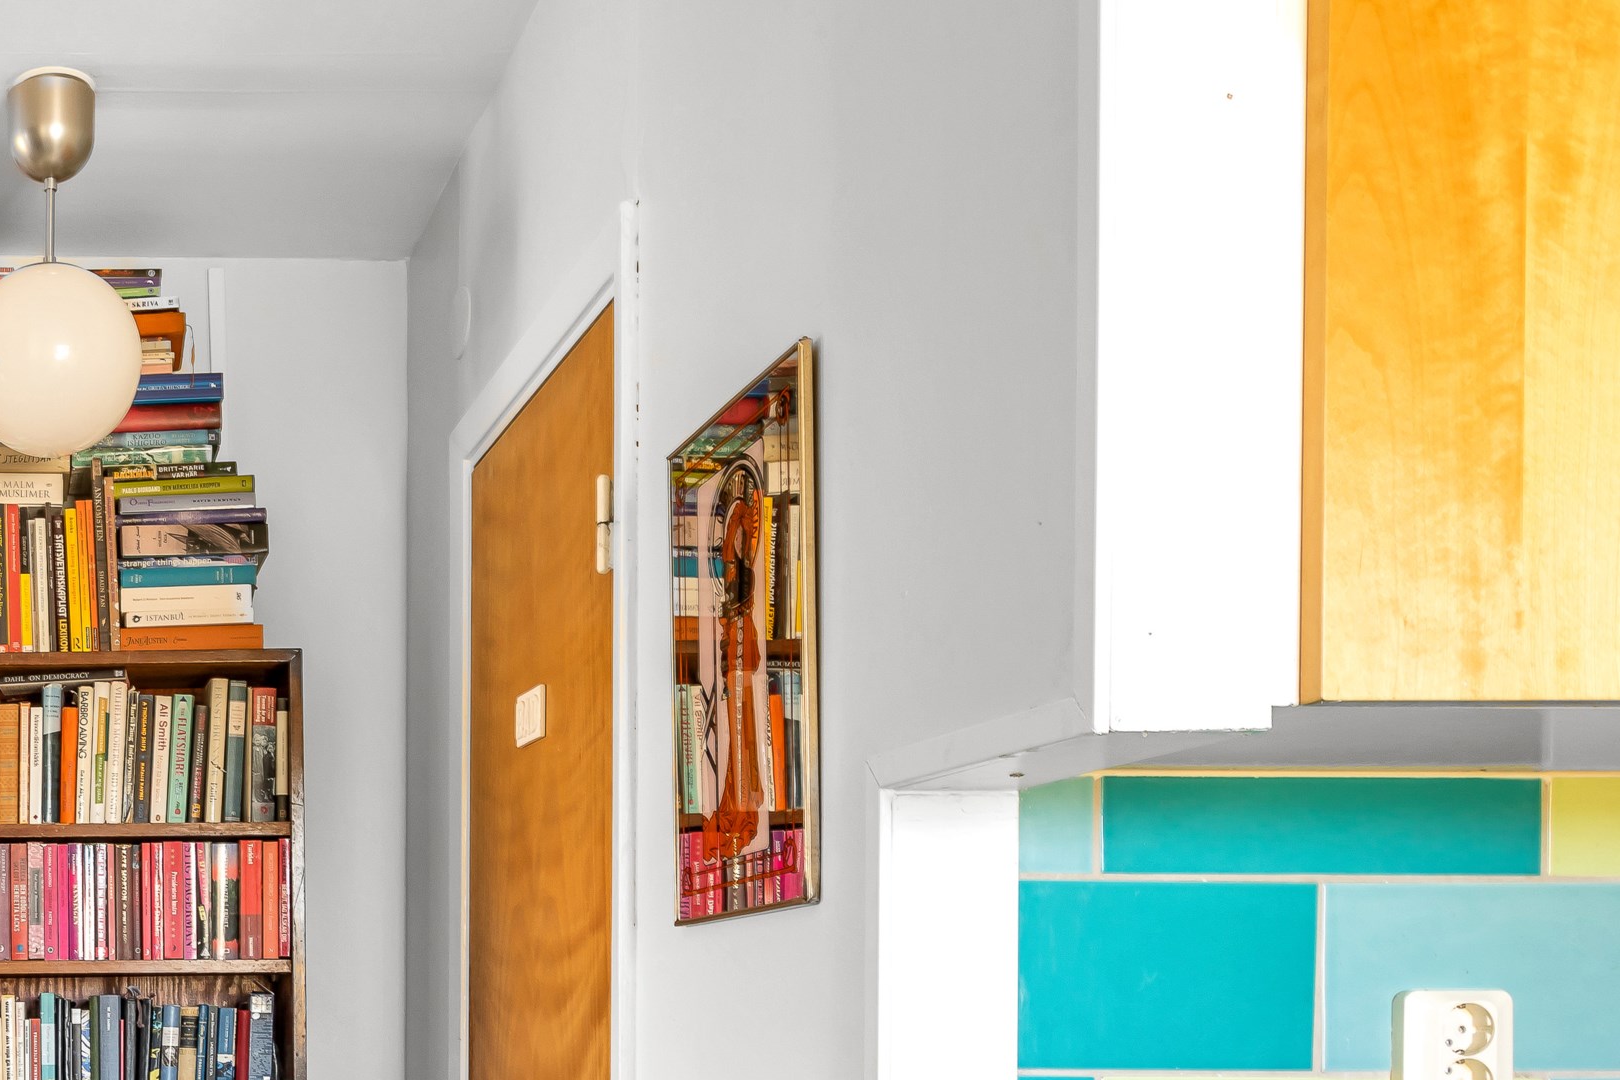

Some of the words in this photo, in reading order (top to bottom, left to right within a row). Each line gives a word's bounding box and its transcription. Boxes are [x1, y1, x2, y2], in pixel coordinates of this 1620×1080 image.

[113, 471, 154, 479] BACKMAN
[158, 464, 205, 473] BRITT-MARIE
[0, 489, 51, 498] MUSLIMER
[94, 486, 104, 542] ANKOMSTEN
[55, 534, 66, 617] STATSVETENSKAPLIGT
[122, 559, 155, 568] stranger
[146, 611, 186, 621] ISTANBUL
[59, 619, 68, 652] LEXIKON
[4, 675, 25, 683] DAHL
[43, 672, 90, 680] DEMOCRACY
[80, 691, 89, 726] BARBRO
[114, 686, 122, 726] VILHELM
[159, 703, 168, 717] Ali
[213, 686, 222, 720] ERNST
[78, 726, 88, 759] ALVING
[112, 728, 121, 767] MOBERG
[157, 720, 169, 751] Smith
[175, 717, 188, 777] FLATSHARE
[184, 877, 193, 947] DAGERMAN
